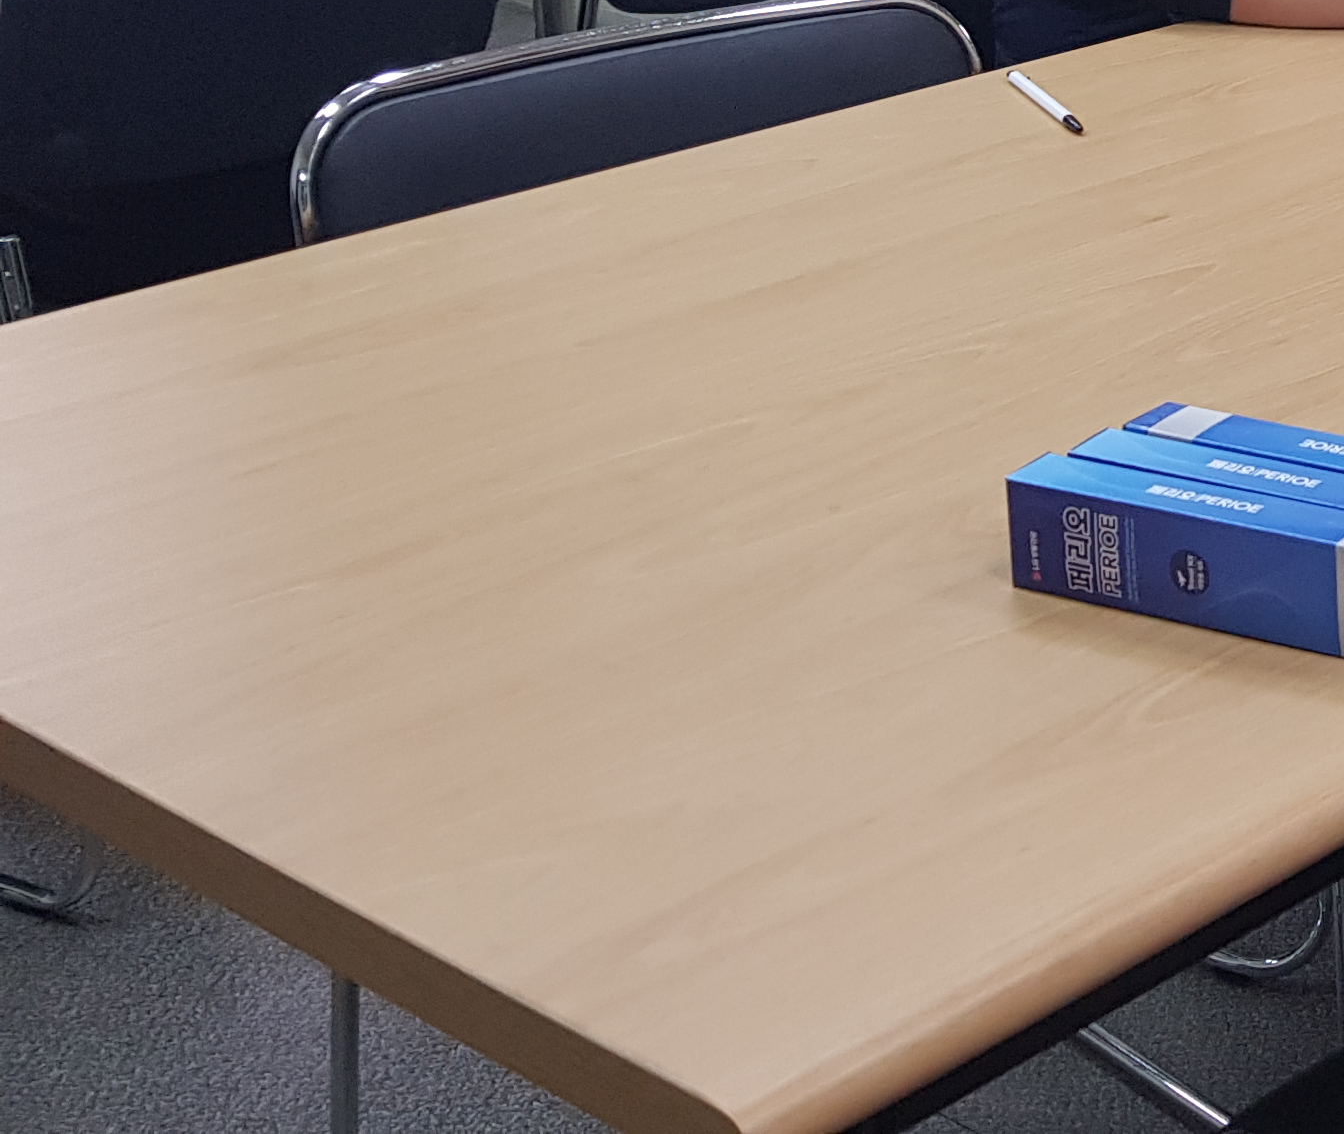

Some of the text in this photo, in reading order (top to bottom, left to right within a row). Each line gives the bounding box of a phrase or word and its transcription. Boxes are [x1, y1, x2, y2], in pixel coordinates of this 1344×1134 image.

[1194, 493, 1265, 514] PERIOE
[1254, 468, 1323, 489] PERIOE
[1062, 506, 1094, 594] 페리오
[1099, 513, 1123, 599] PERIOE
